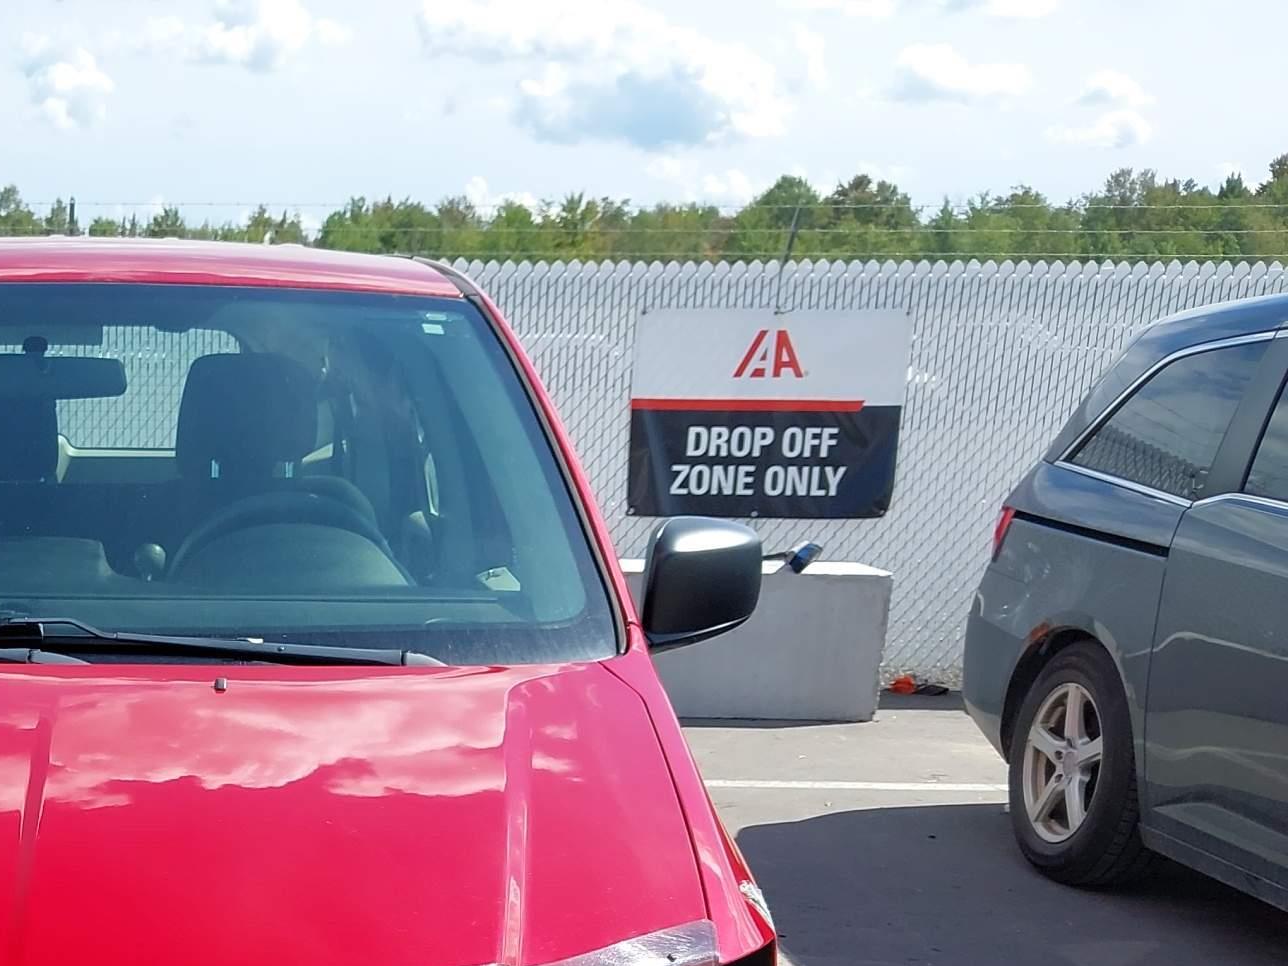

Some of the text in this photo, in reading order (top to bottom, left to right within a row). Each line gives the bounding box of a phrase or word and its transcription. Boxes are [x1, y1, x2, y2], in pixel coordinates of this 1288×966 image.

[685, 425, 840, 458] DROP OFF
[669, 464, 847, 497] ZONE ONLY
